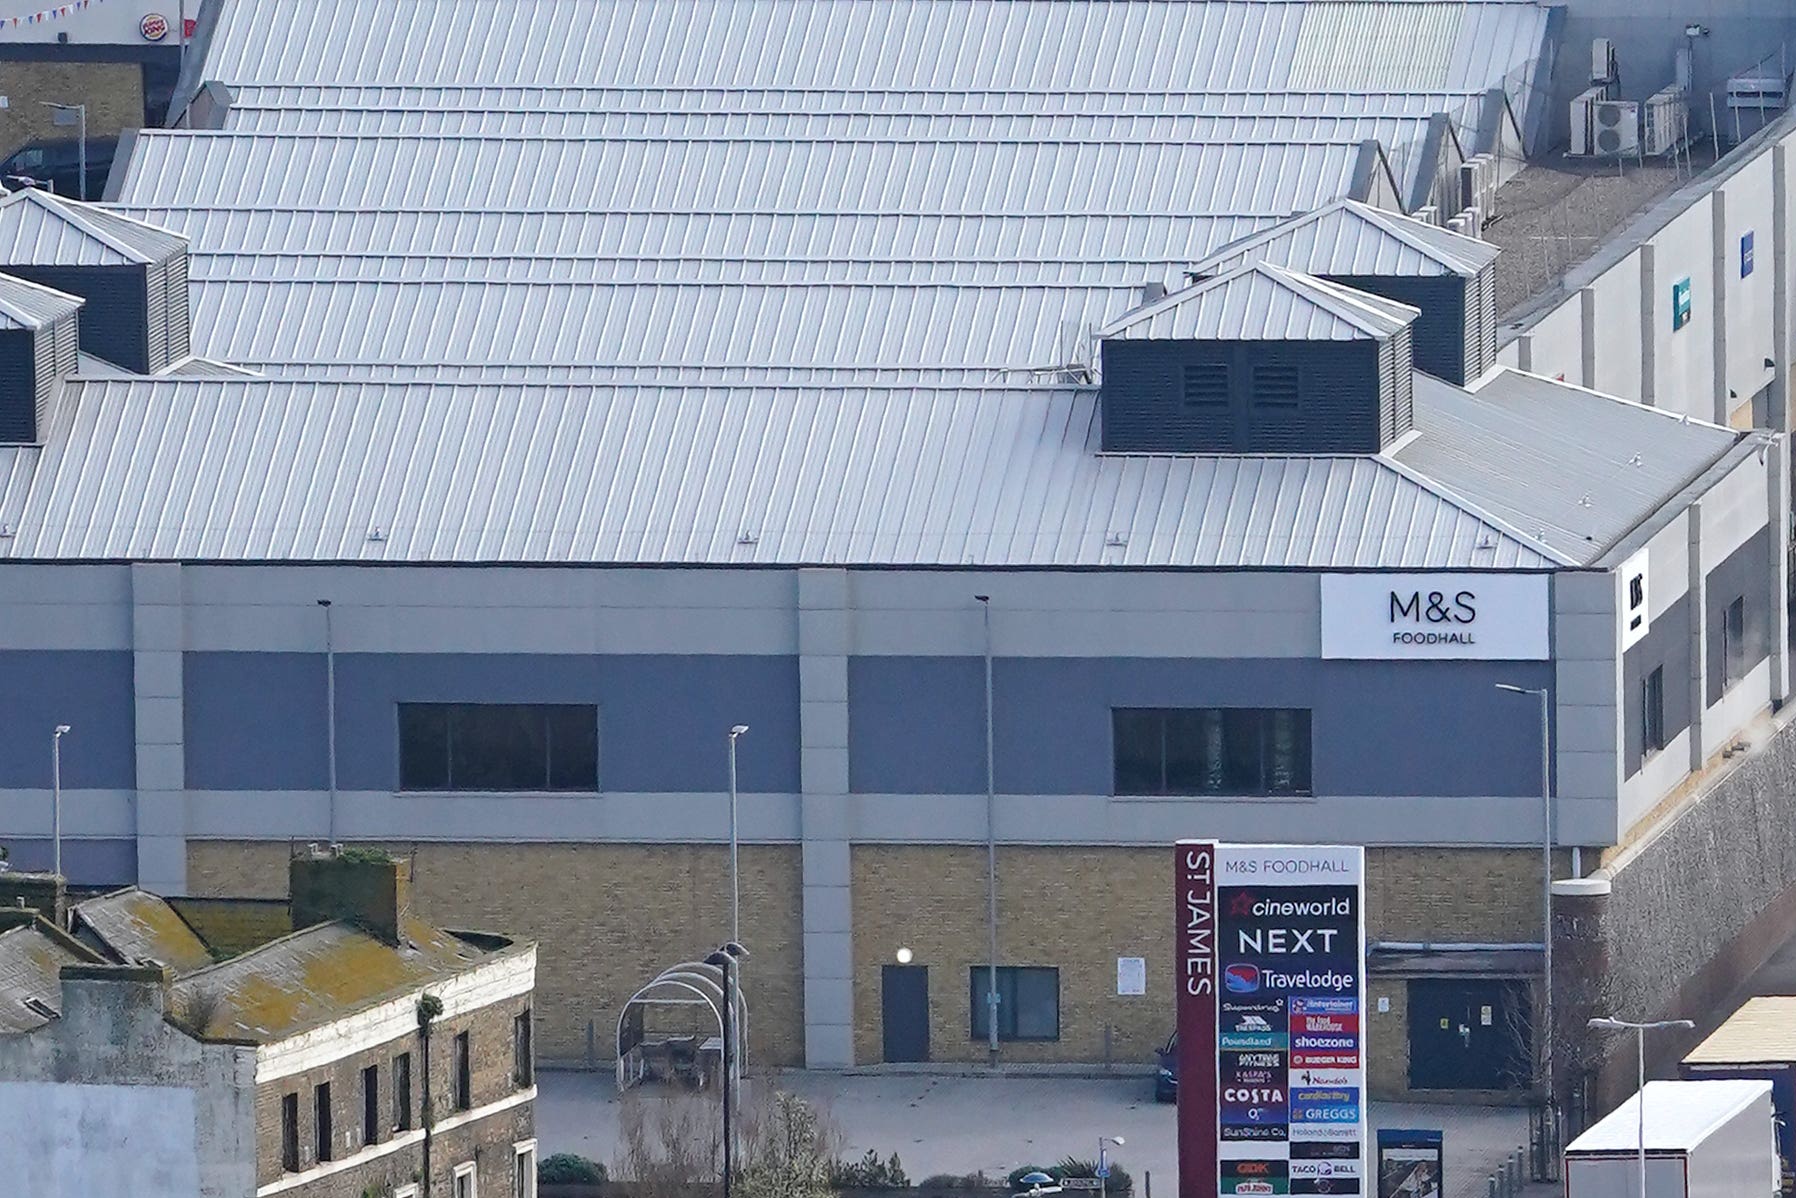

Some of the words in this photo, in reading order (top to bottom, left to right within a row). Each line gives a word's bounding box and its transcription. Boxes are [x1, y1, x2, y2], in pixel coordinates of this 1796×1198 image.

[1389, 591, 1476, 624] M&S
[1393, 632, 1475, 645] FOODHALL
[1225, 860, 1257, 873] M&S
[1263, 860, 1349, 873] FOODHALL
[1252, 898, 1350, 916] cineworld
[1187, 890, 1211, 996] JAMES
[1238, 929, 1338, 954] NEXT
[1262, 970, 1353, 991] Travelodge
[1295, 1037, 1353, 1047] shoezone
[1224, 1088, 1283, 1103] COSTA
[1306, 1108, 1356, 1119] GREGGS
